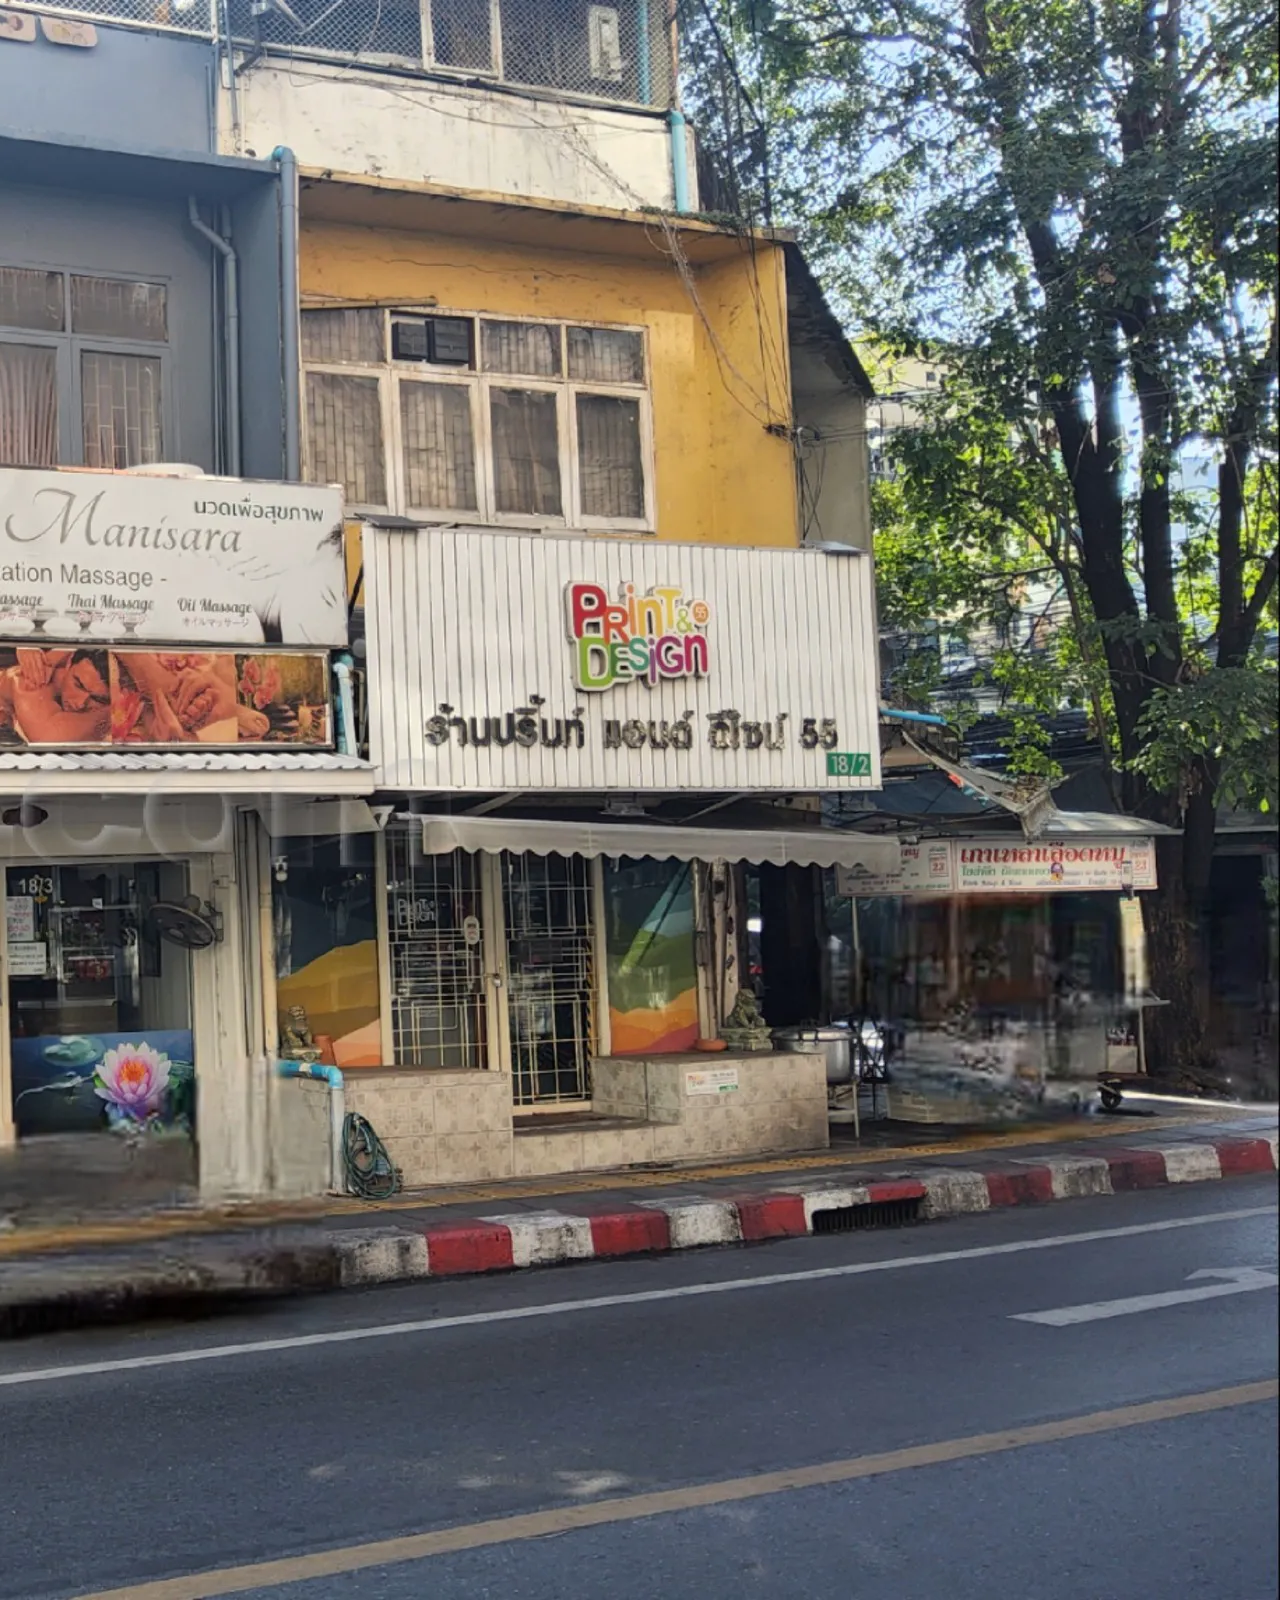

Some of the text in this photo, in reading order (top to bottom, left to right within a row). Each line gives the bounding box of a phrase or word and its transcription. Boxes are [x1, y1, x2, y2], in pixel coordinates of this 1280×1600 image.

[5, 488, 242, 553] Manisara
[193, 493, 325, 525] นวดเพื่อสุขภาพ
[60, 563, 154, 591] Massage
[67, 593, 155, 613] Thai Massage
[176, 598, 253, 617] Oil Massage
[602, 710, 695, 750] แอนด์
[799, 717, 839, 750] 55
[830, 755, 869, 775] 18/2
